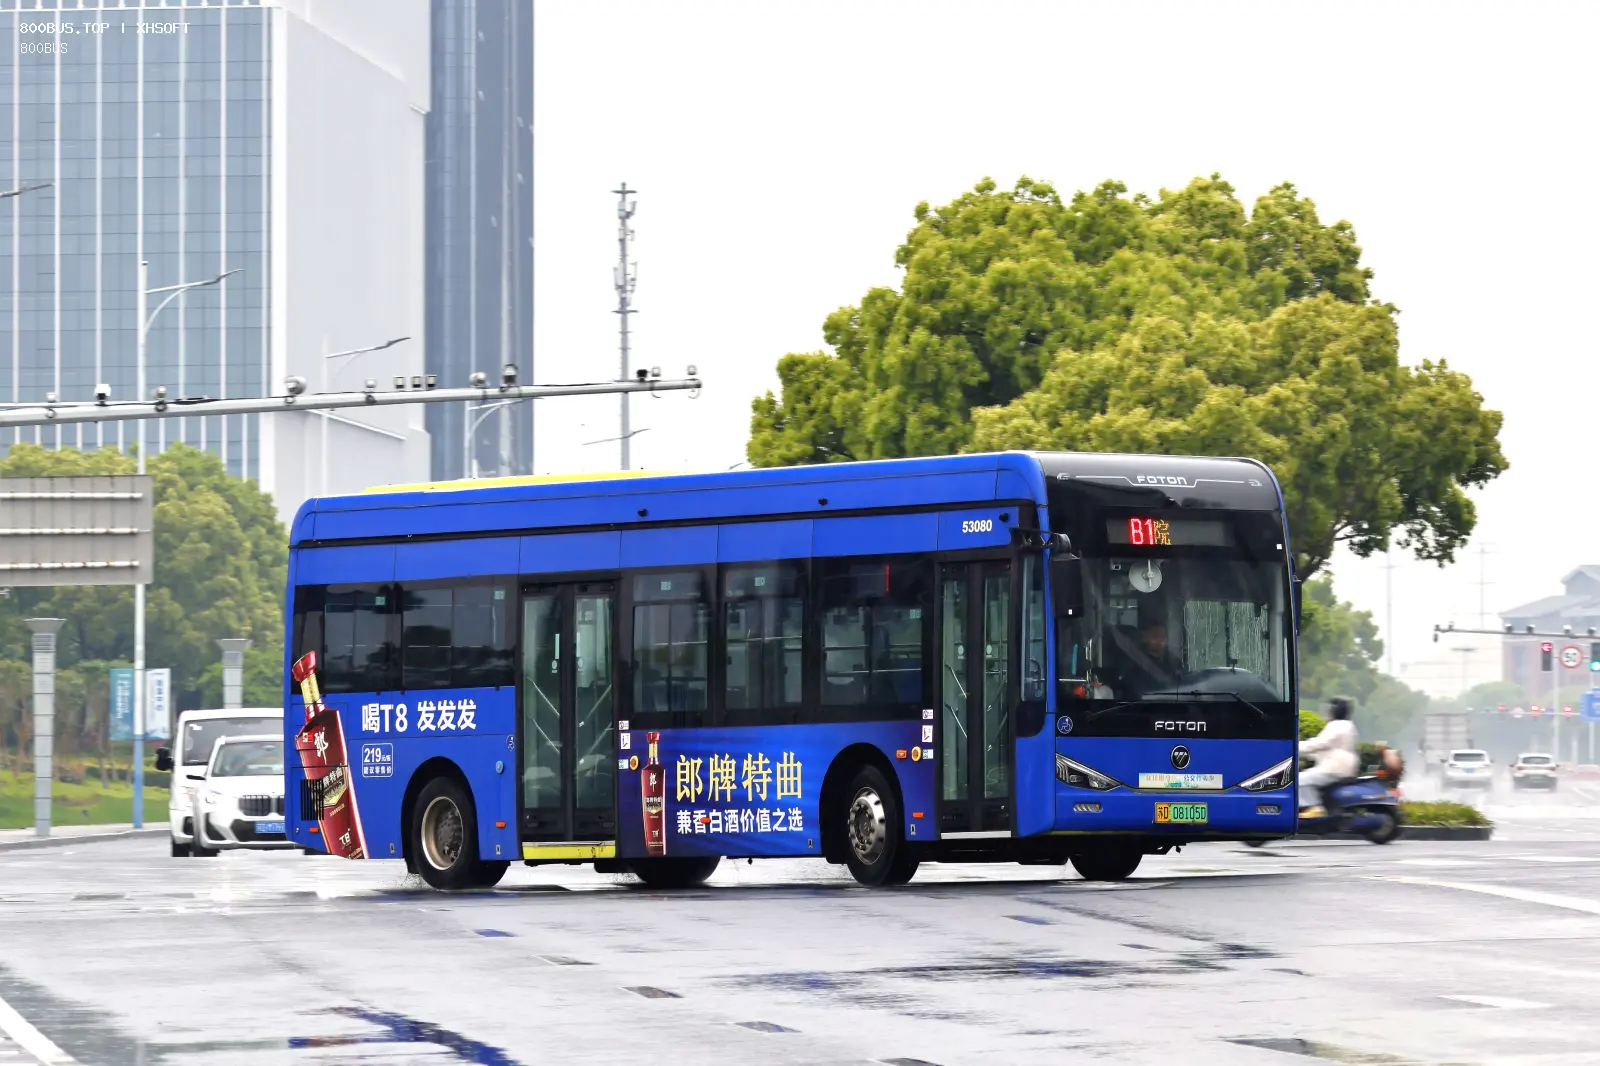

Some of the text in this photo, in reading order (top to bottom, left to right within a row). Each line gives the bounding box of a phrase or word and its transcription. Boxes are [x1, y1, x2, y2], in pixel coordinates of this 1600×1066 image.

[1136, 475, 1188, 485] FOTON
[962, 519, 993, 533] 53080
[1129, 518, 1154, 545] B1
[362, 699, 477, 733] 喝T8 发发发
[1155, 721, 1206, 731] FOTON
[676, 751, 803, 803] 郎牌特曲
[676, 807, 803, 834] 兼香白酒价值之选
[1172, 806, 1207, 820] 08105D
